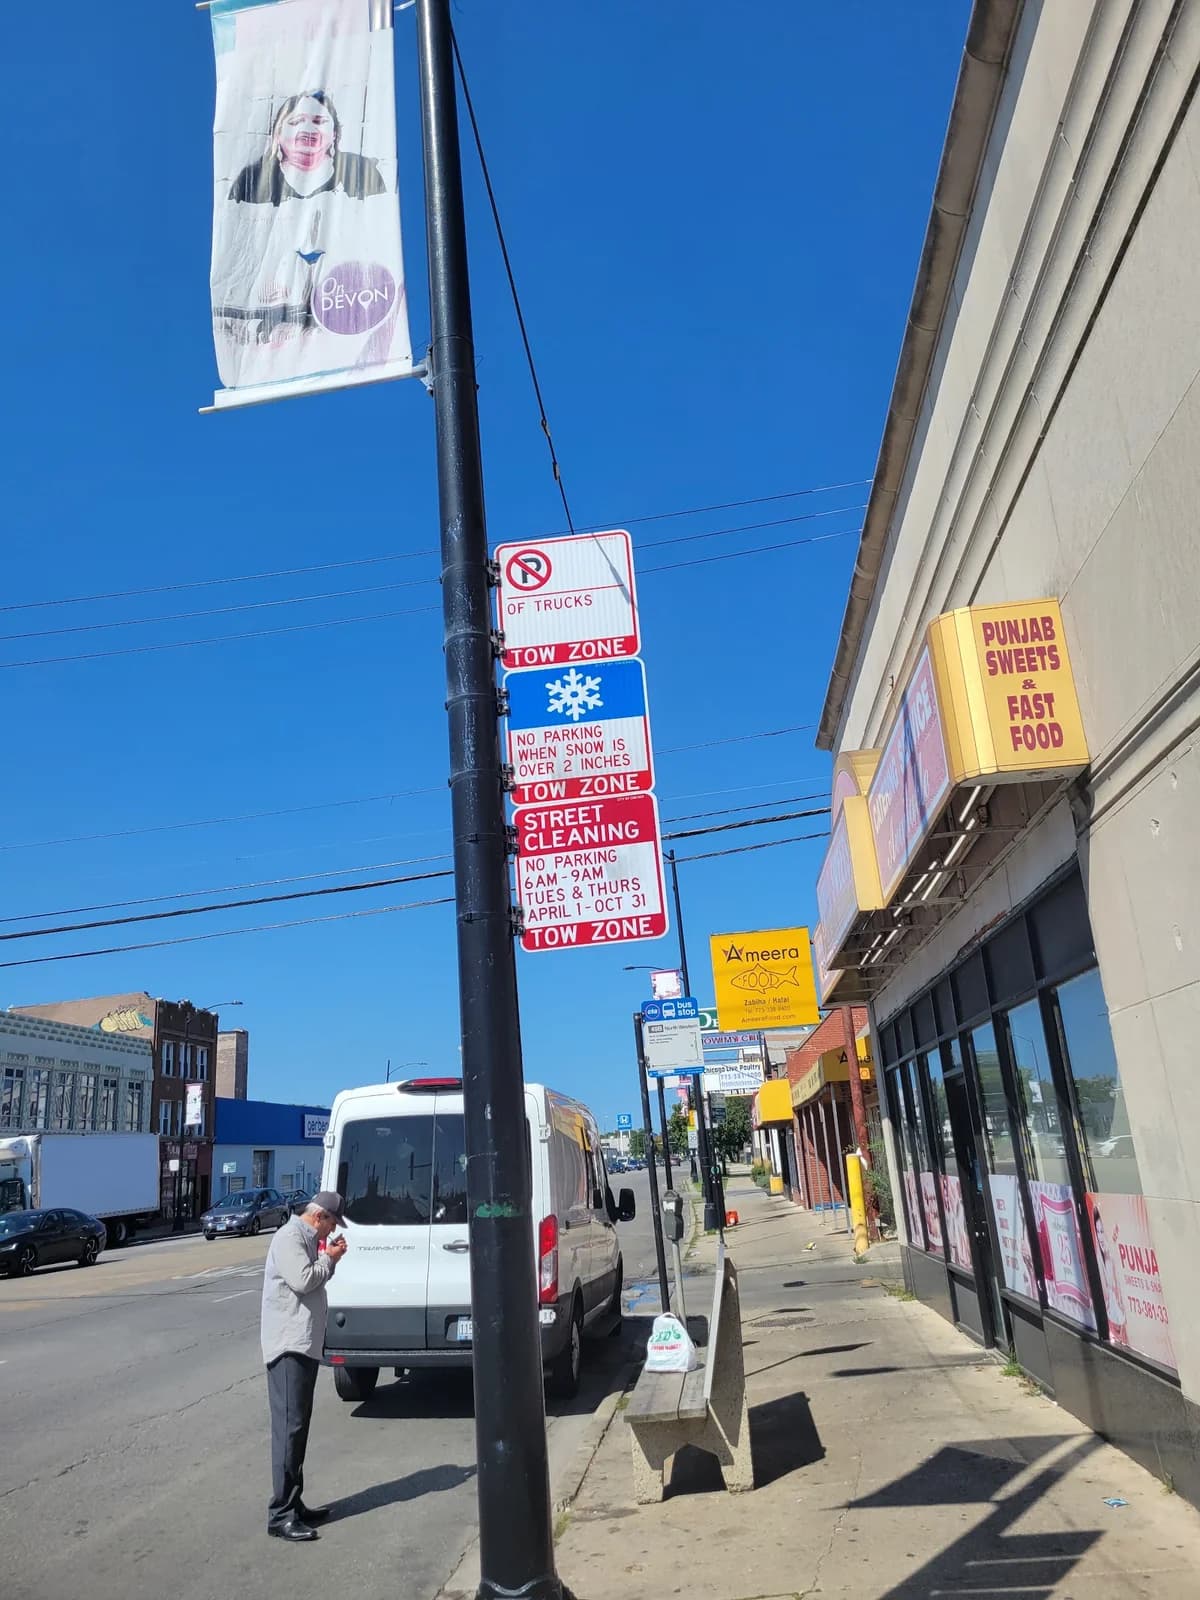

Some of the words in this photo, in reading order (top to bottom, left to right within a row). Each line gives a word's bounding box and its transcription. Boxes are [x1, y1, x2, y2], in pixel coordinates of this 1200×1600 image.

[322, 277, 344, 296] On
[322, 287, 388, 311] DEVON
[507, 602, 525, 616] OF
[534, 594, 593, 612] TRUCKS
[982, 616, 1056, 646] PUNJAB
[510, 646, 556, 666] TOW
[568, 638, 626, 660] ZONE
[985, 645, 1061, 676] SWEETS
[1022, 678, 1037, 690] &
[1006, 693, 1055, 720] FAST
[516, 732, 536, 746] NO
[544, 726, 602, 744] PARKING
[1010, 722, 1064, 752] FOOD
[518, 746, 557, 762] WHEN
[566, 740, 604, 757] SNOW
[612, 738, 626, 752] IS
[519, 762, 555, 777] OVER
[564, 760, 572, 772] 2
[580, 754, 631, 770] INCHES
[520, 782, 567, 802] TOW
[580, 774, 640, 796] ZONE
[524, 805, 604, 831] STREET
[524, 821, 640, 851] CLEANING
[526, 858, 545, 873] NO
[554, 850, 618, 868] PARKING
[526, 888, 566, 906] TUES
[572, 886, 583, 900] &
[588, 878, 641, 896] THURS
[528, 907, 572, 922] APRIL
[632, 894, 646, 908] 31
[530, 924, 578, 948] TOW
[591, 916, 654, 940] ZONE
[722, 944, 799, 963] Ameera
[742, 972, 780, 988] FOOD
